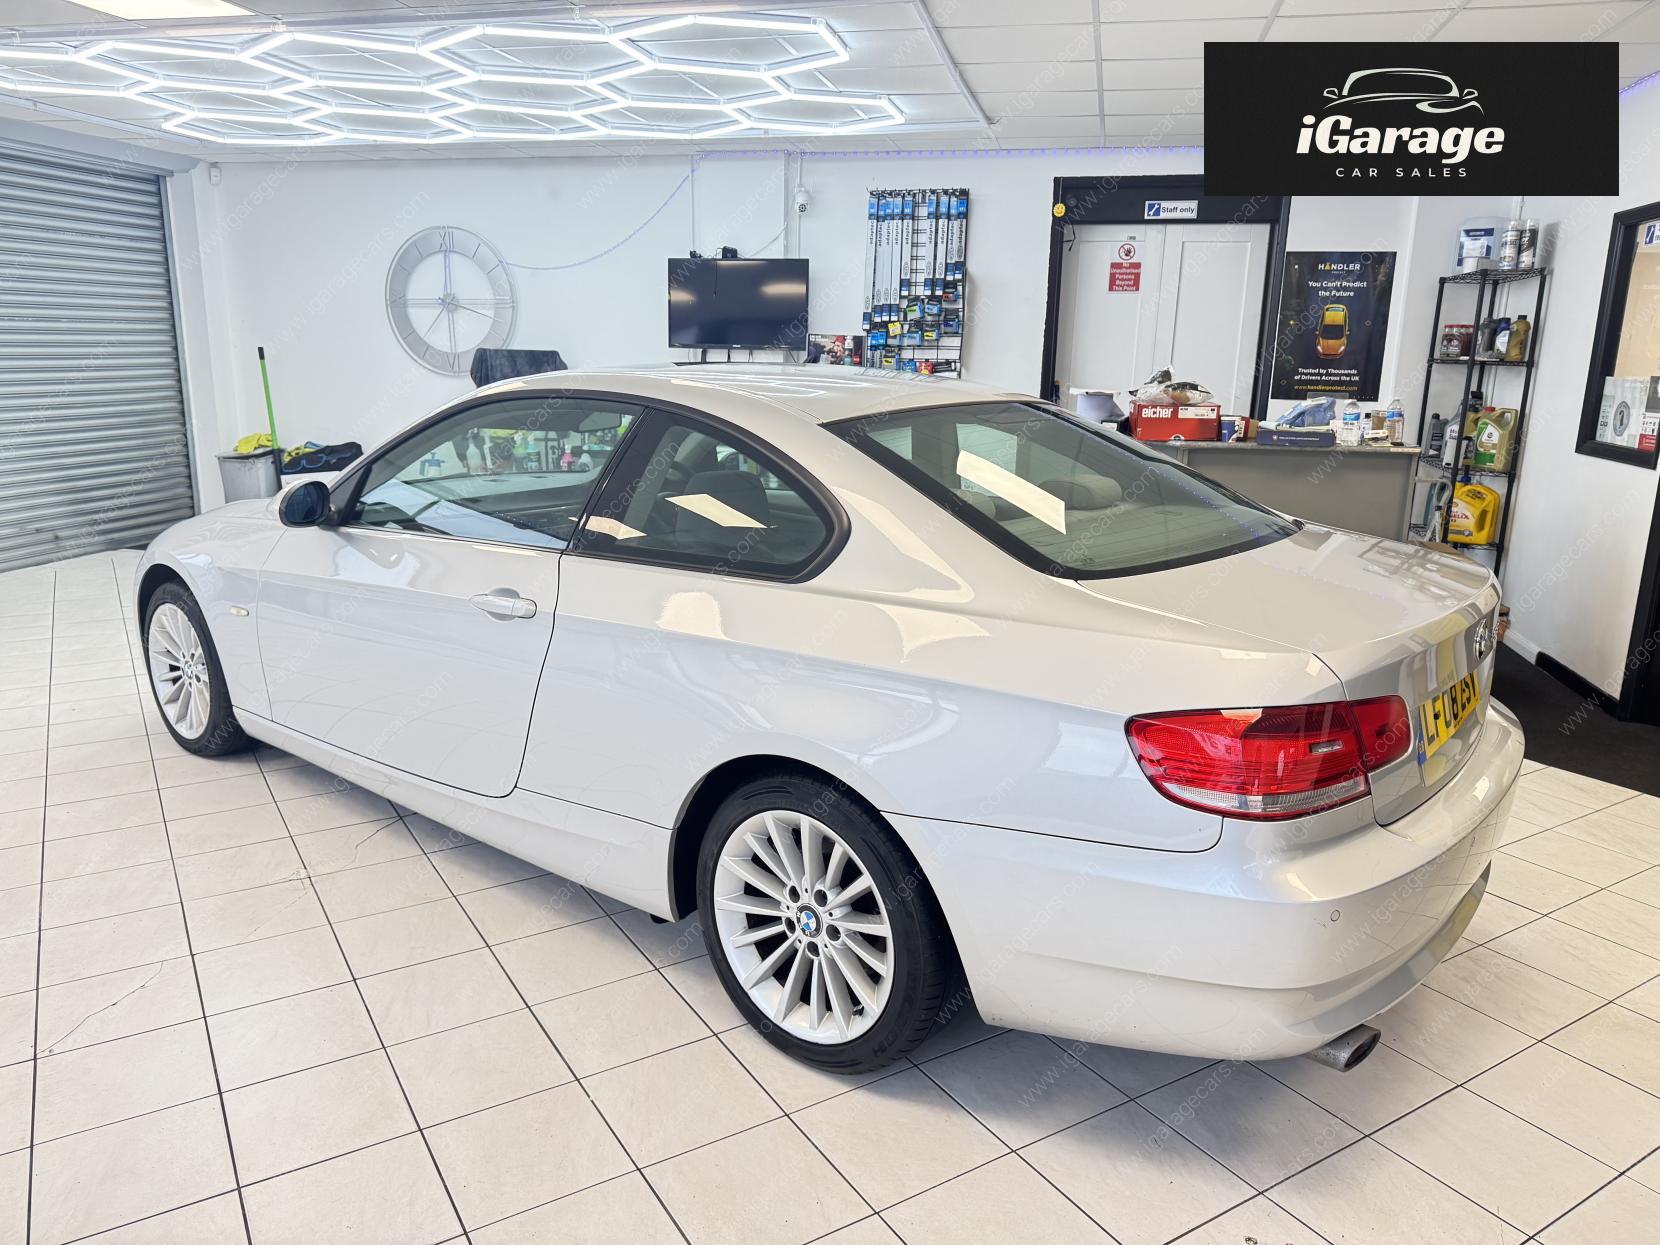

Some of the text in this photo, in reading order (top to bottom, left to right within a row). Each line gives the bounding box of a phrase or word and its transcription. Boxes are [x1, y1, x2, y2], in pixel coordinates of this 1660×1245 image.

[1180, 206, 1194, 214] only
[1141, 406, 1173, 418] eicher
[1422, 684, 1459, 746] LF08
